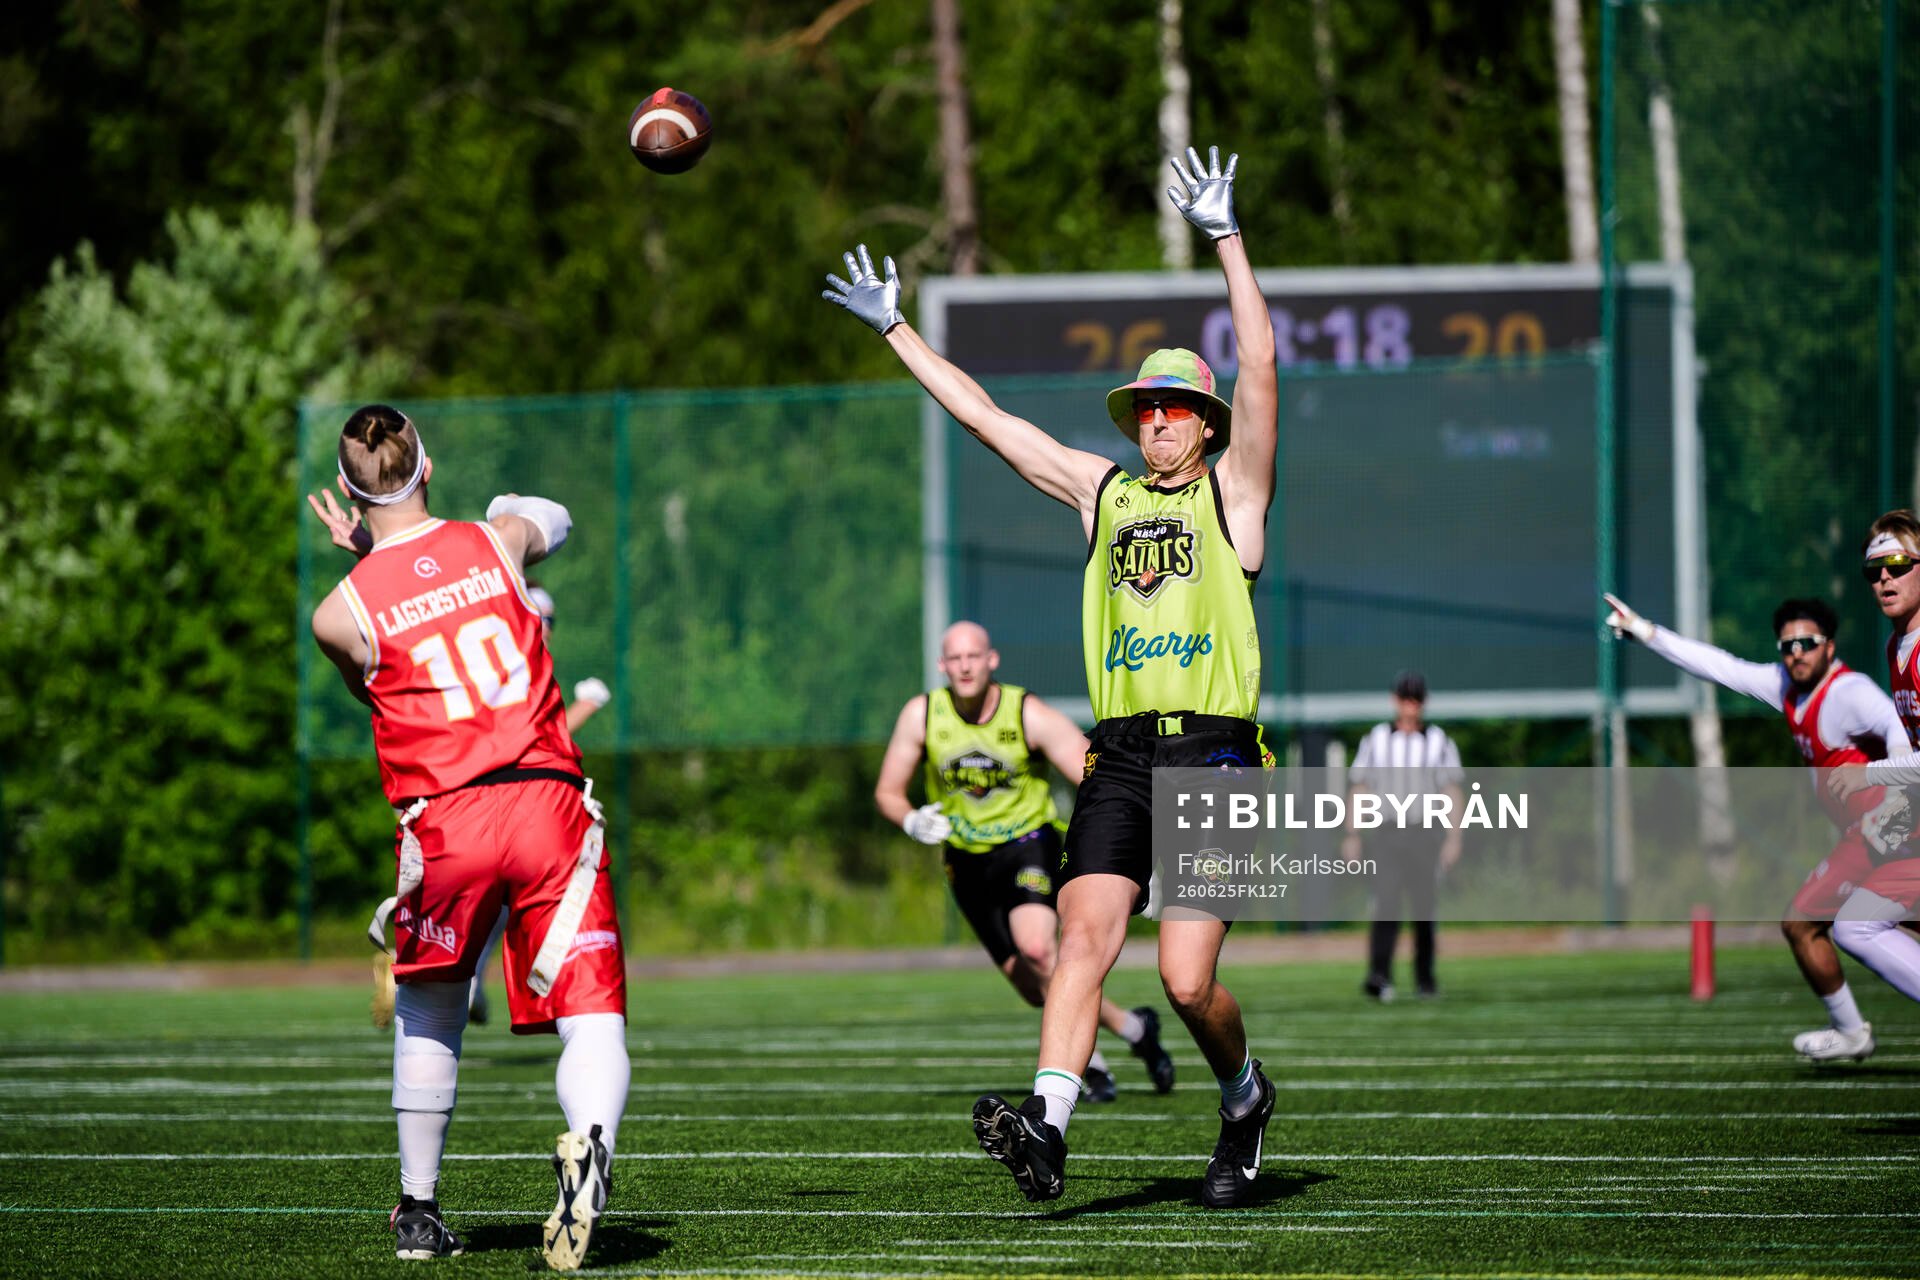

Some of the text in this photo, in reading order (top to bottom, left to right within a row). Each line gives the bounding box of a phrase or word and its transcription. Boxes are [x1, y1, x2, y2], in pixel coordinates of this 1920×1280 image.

[1112, 536, 1191, 584] SAINTS
[376, 565, 508, 637] LAGERSTRÖM
[408, 613, 532, 721] 10
